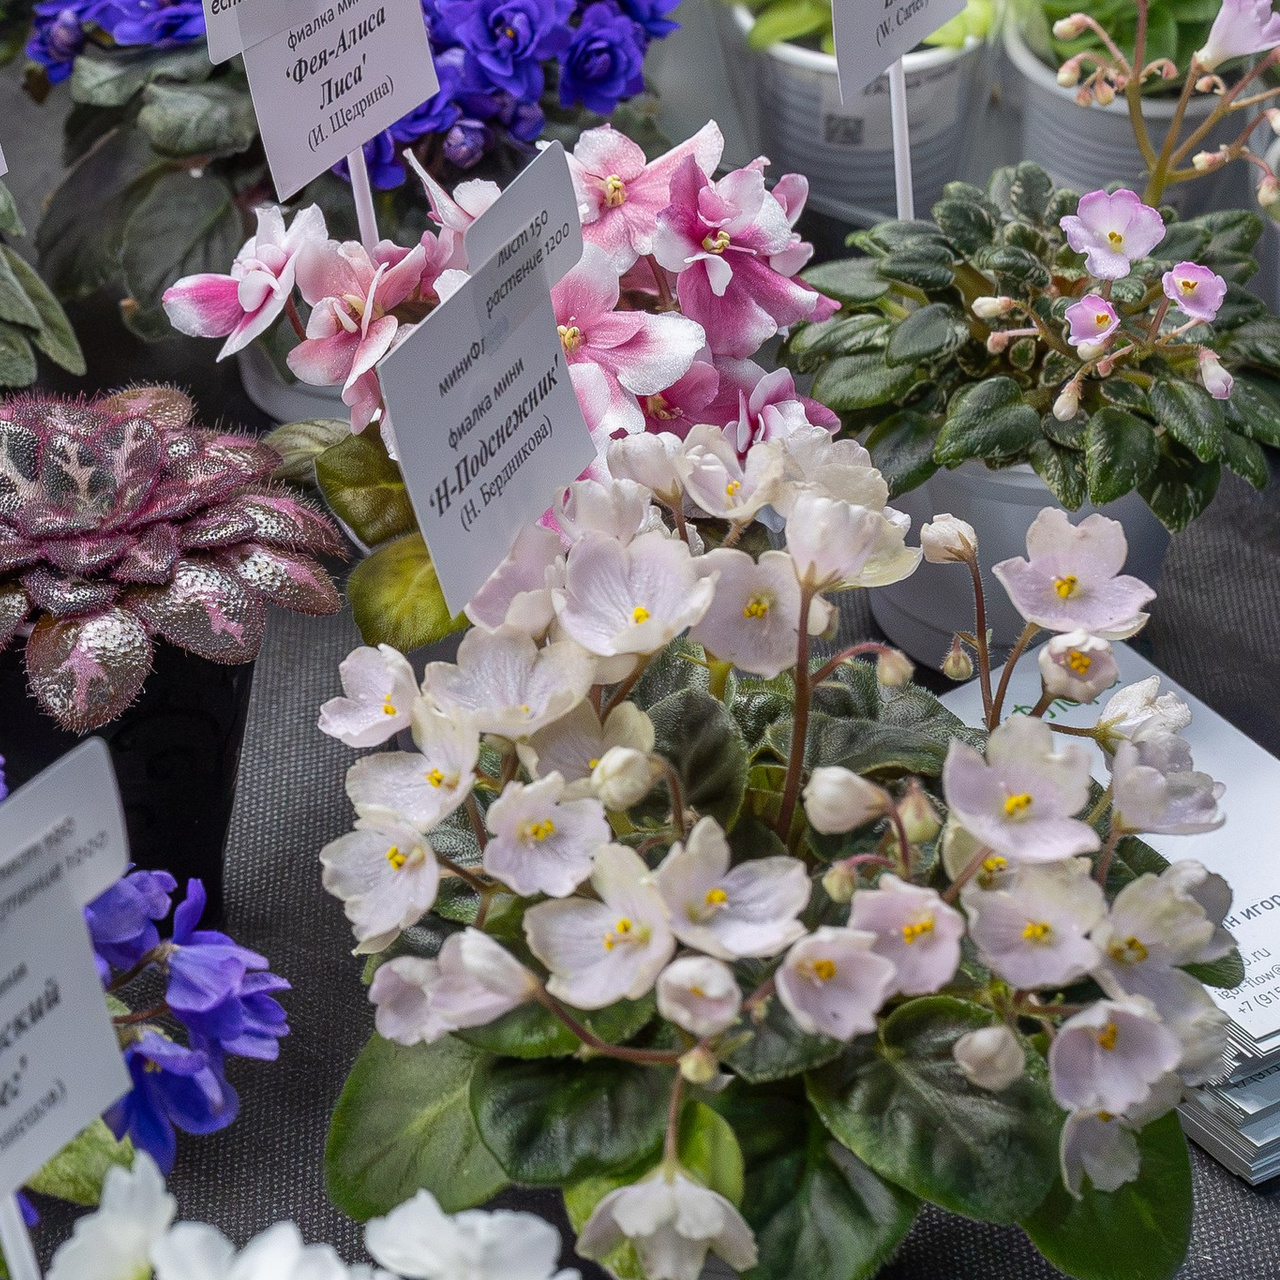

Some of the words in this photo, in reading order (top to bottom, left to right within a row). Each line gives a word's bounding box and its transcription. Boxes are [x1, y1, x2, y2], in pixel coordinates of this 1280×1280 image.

[287, 7, 336, 54] фиалка
[875, 19, 893, 47] (W.
[318, 53, 369, 112] Лиса'
[306, 123, 331, 154] (И.
[329, 74, 396, 137] Щедрина)
[495, 230, 529, 269] лист
[529, 209, 550, 241] 150
[484, 246, 544, 320] растение
[544, 222, 571, 257] 1200
[446, 396, 494, 451] фиалка
[493, 357, 525, 402] мини
[459, 495, 481, 533] (Н.
[477, 413, 554, 500] Бердникова)
[1238, 1000, 1254, 1014] +7
